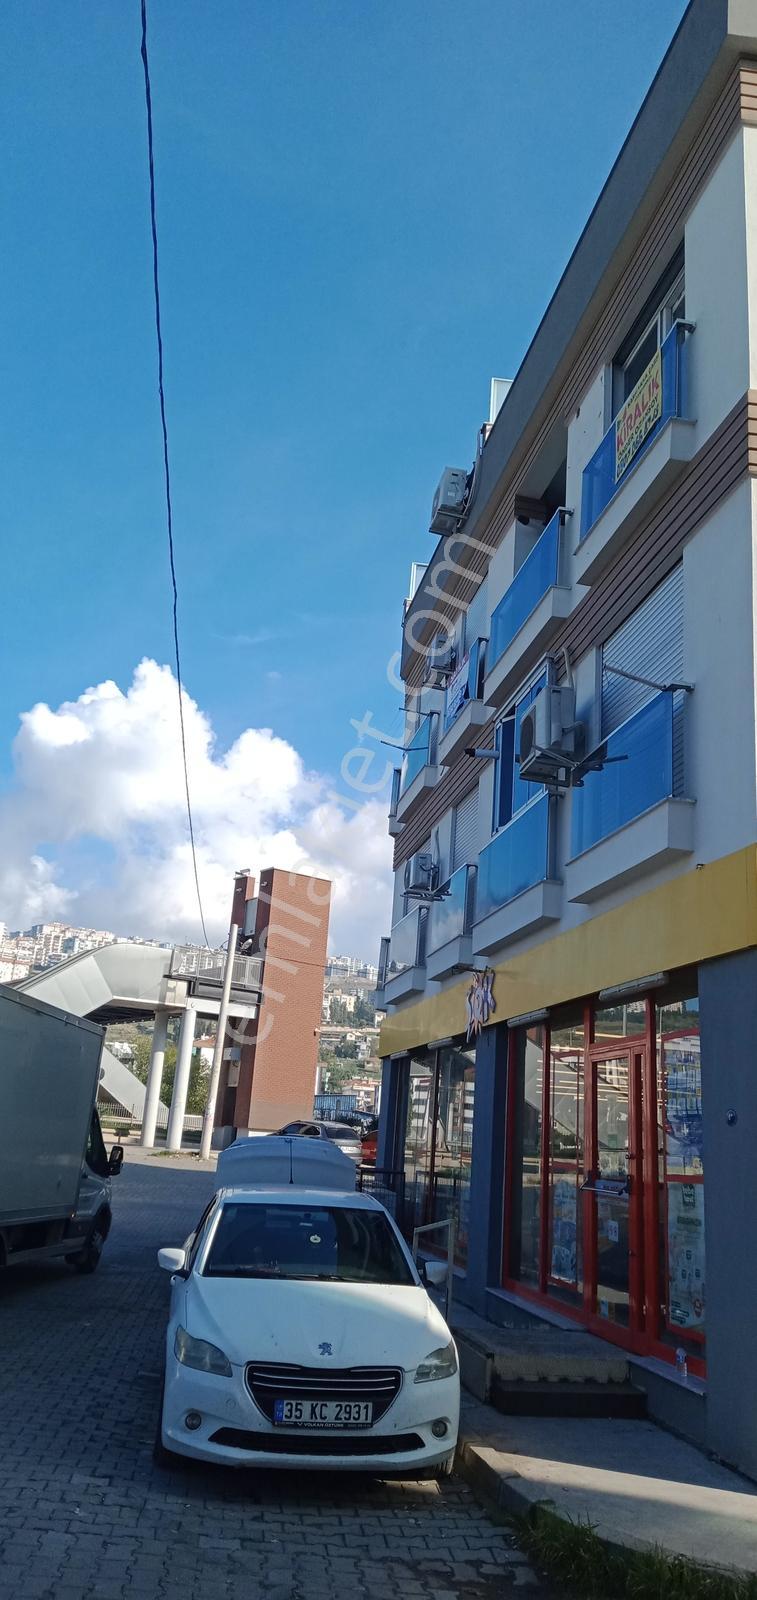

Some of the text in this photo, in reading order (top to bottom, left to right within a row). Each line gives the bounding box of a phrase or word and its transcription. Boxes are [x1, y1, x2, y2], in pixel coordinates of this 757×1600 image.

[284, 1402, 303, 1420] 35
[310, 1402, 328, 1420] KC
[334, 1403, 370, 1421] 2931
